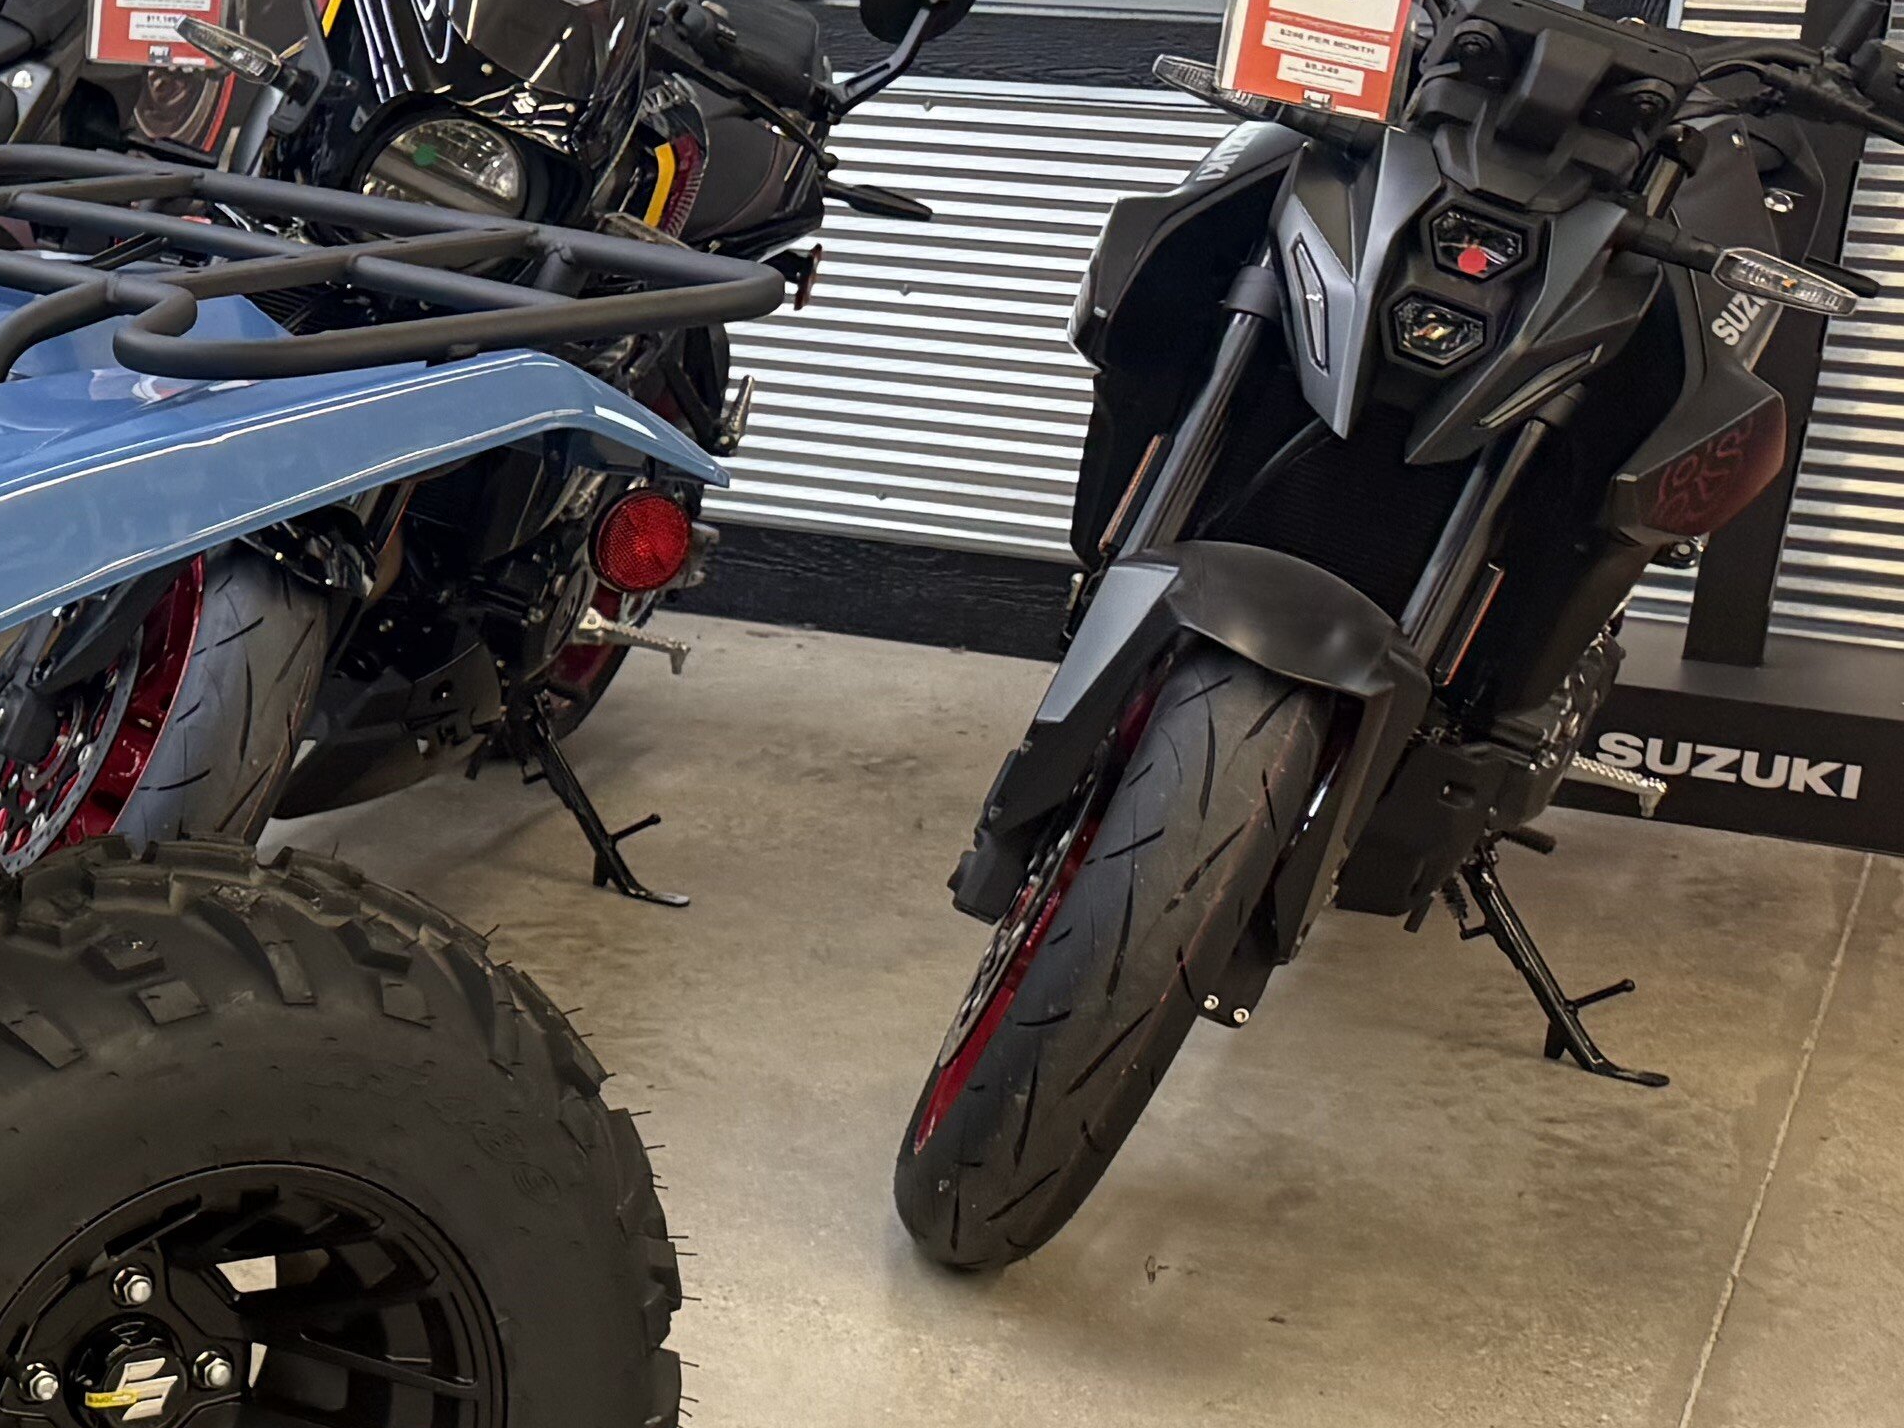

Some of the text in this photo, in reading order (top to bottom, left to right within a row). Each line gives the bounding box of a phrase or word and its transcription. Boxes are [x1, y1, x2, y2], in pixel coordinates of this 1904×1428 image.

[1308, 34, 1330, 45] PER
[1334, 38, 1377, 54] MONTH
[1596, 730, 1863, 800] SUZUKI
